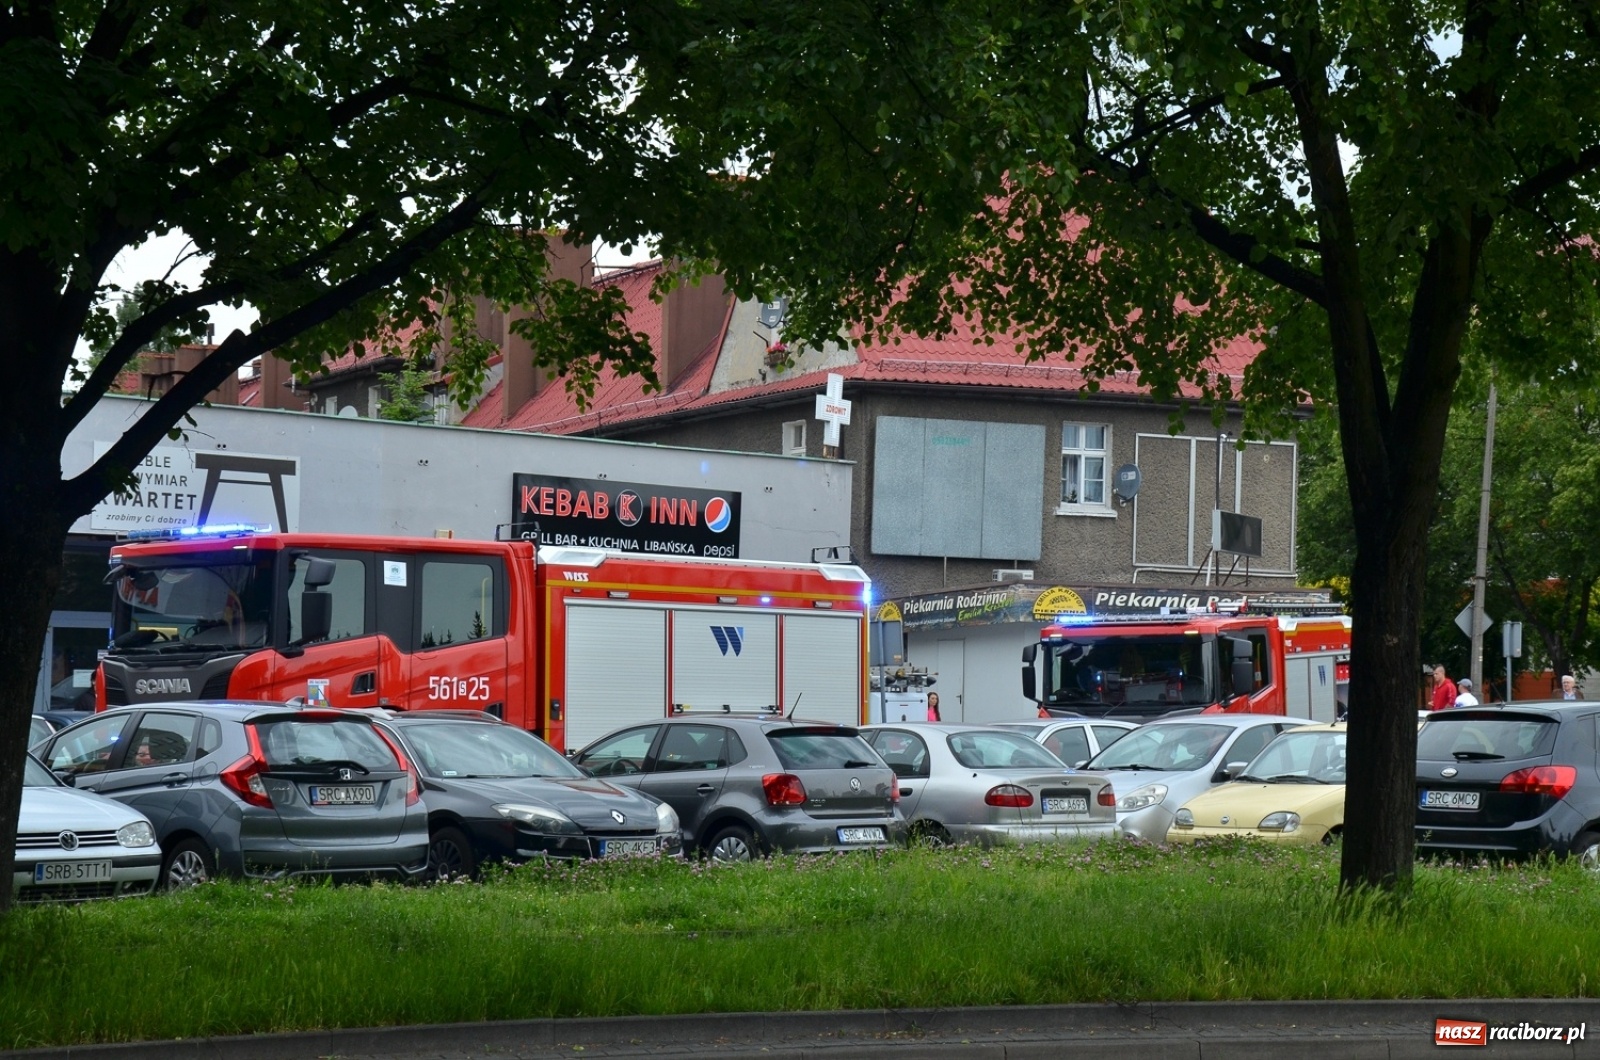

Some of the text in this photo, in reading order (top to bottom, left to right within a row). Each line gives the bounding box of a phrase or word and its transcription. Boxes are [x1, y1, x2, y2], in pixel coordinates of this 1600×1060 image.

[139, 455, 171, 468] BLE
[521, 485, 609, 519] KEBAB
[650, 496, 697, 527] INN
[106, 514, 188, 525] zrobimy Ci dobrze
[555, 534, 578, 546] BAR
[588, 537, 640, 551] KUCHNIA
[644, 539, 696, 555] LIBAŃSKA
[703, 543, 735, 558] pepsi
[903, 595, 954, 615] Piekarnia
[956, 591, 1007, 609] Rodzinna
[1095, 592, 1199, 608] Piekarnia
[135, 678, 191, 695] SCANIA
[319, 787, 372, 801] SRC AX90
[1427, 792, 1478, 805] SRC 6MC9
[1047, 800, 1065, 810] SRC
[843, 829, 861, 840] SRC
[606, 841, 629, 854] SRC
[45, 863, 108, 880] SRB 5TT1
